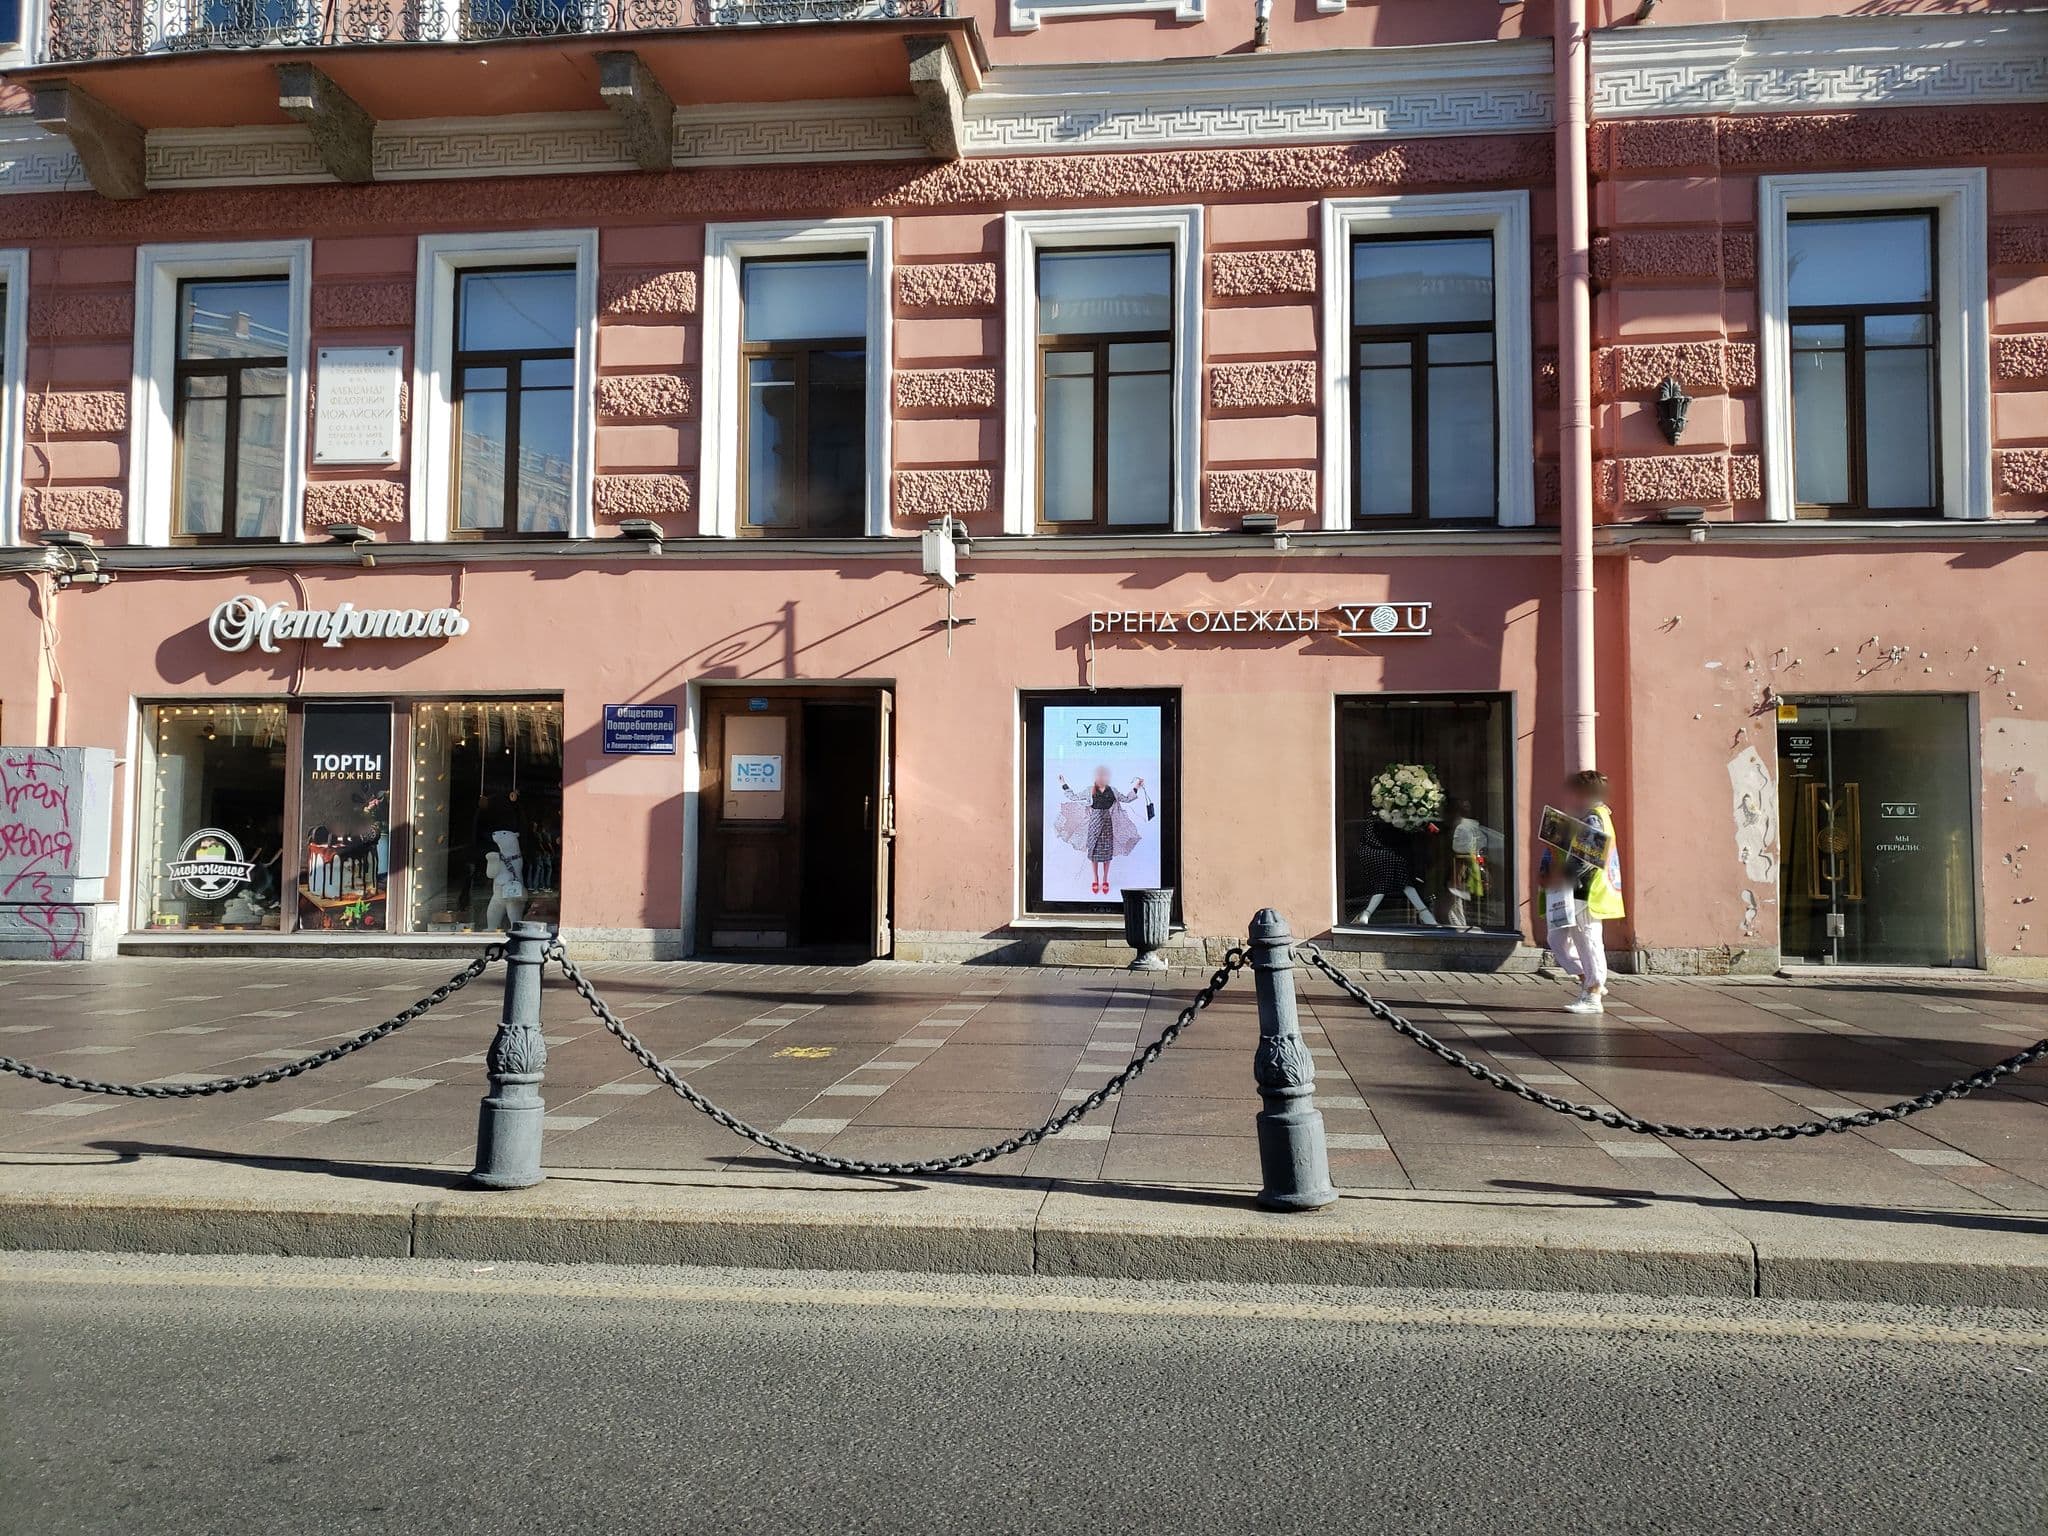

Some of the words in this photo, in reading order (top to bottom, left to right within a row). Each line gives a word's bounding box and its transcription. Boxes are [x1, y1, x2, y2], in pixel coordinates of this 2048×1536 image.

[208, 594, 470, 653] Метрополь
[1091, 610, 1178, 632] БРЕНД
[1187, 609, 1318, 632] ОДЕЖДЫ
[1344, 605, 1427, 633] YOU
[617, 708, 664, 718] Общество
[607, 720, 673, 732] Потребителей
[1083, 722, 1121, 734] YOU
[313, 754, 381, 771] ТОРТЫ
[312, 772, 381, 780] ПИРОЖНЫЕ
[737, 763, 774, 777] NEO
[1886, 806, 1915, 815] YOU
[173, 863, 246, 877] мороженое
